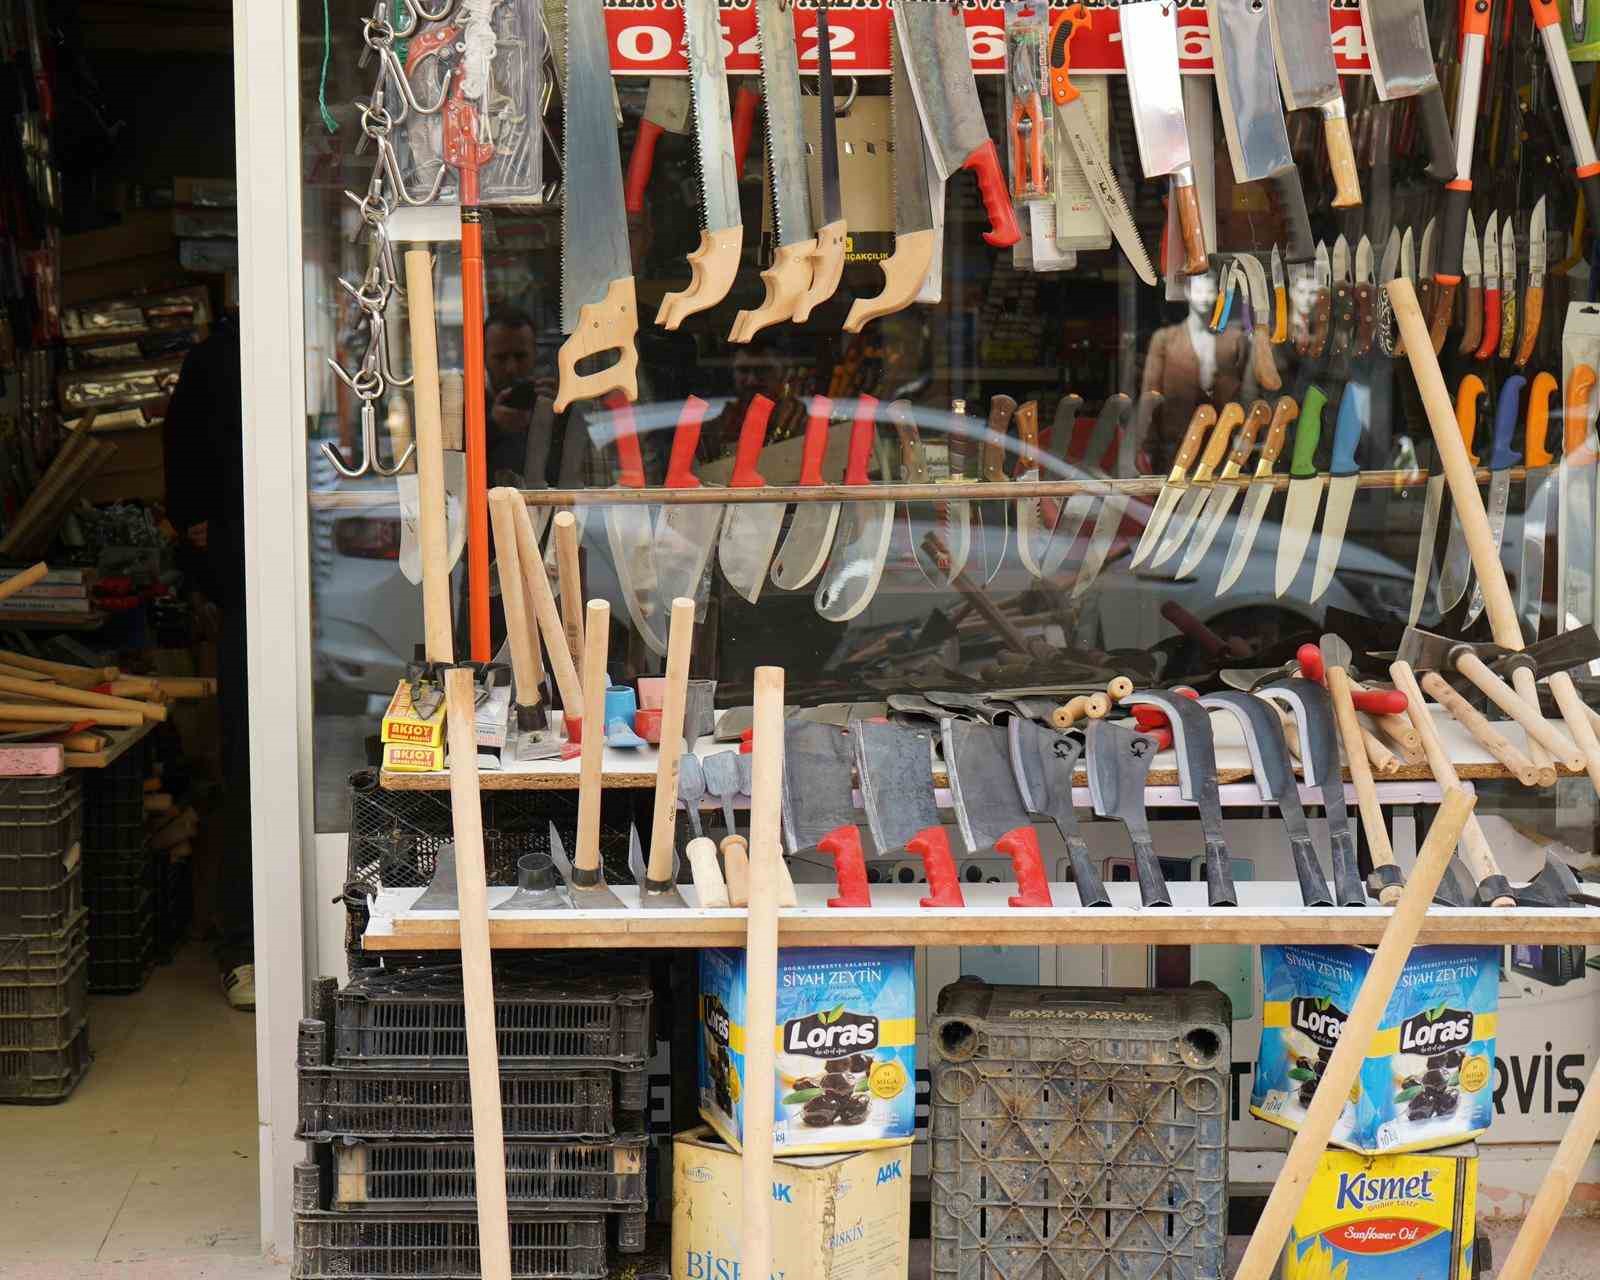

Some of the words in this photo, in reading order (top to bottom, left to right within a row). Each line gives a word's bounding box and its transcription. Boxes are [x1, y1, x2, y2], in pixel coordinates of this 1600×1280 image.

[783, 971, 824, 987] SİYAH
[829, 968, 882, 985] ZEYTİN
[1436, 963, 1478, 982] ZEYTİN
[1297, 1000, 1345, 1038] Lora
[789, 1021, 875, 1050] Loras
[1402, 1018, 1470, 1050] Loras
[876, 1160, 902, 1185] AAK
[1343, 1226, 1397, 1242] Sunflower
[1398, 1227, 1419, 1240] Oil
